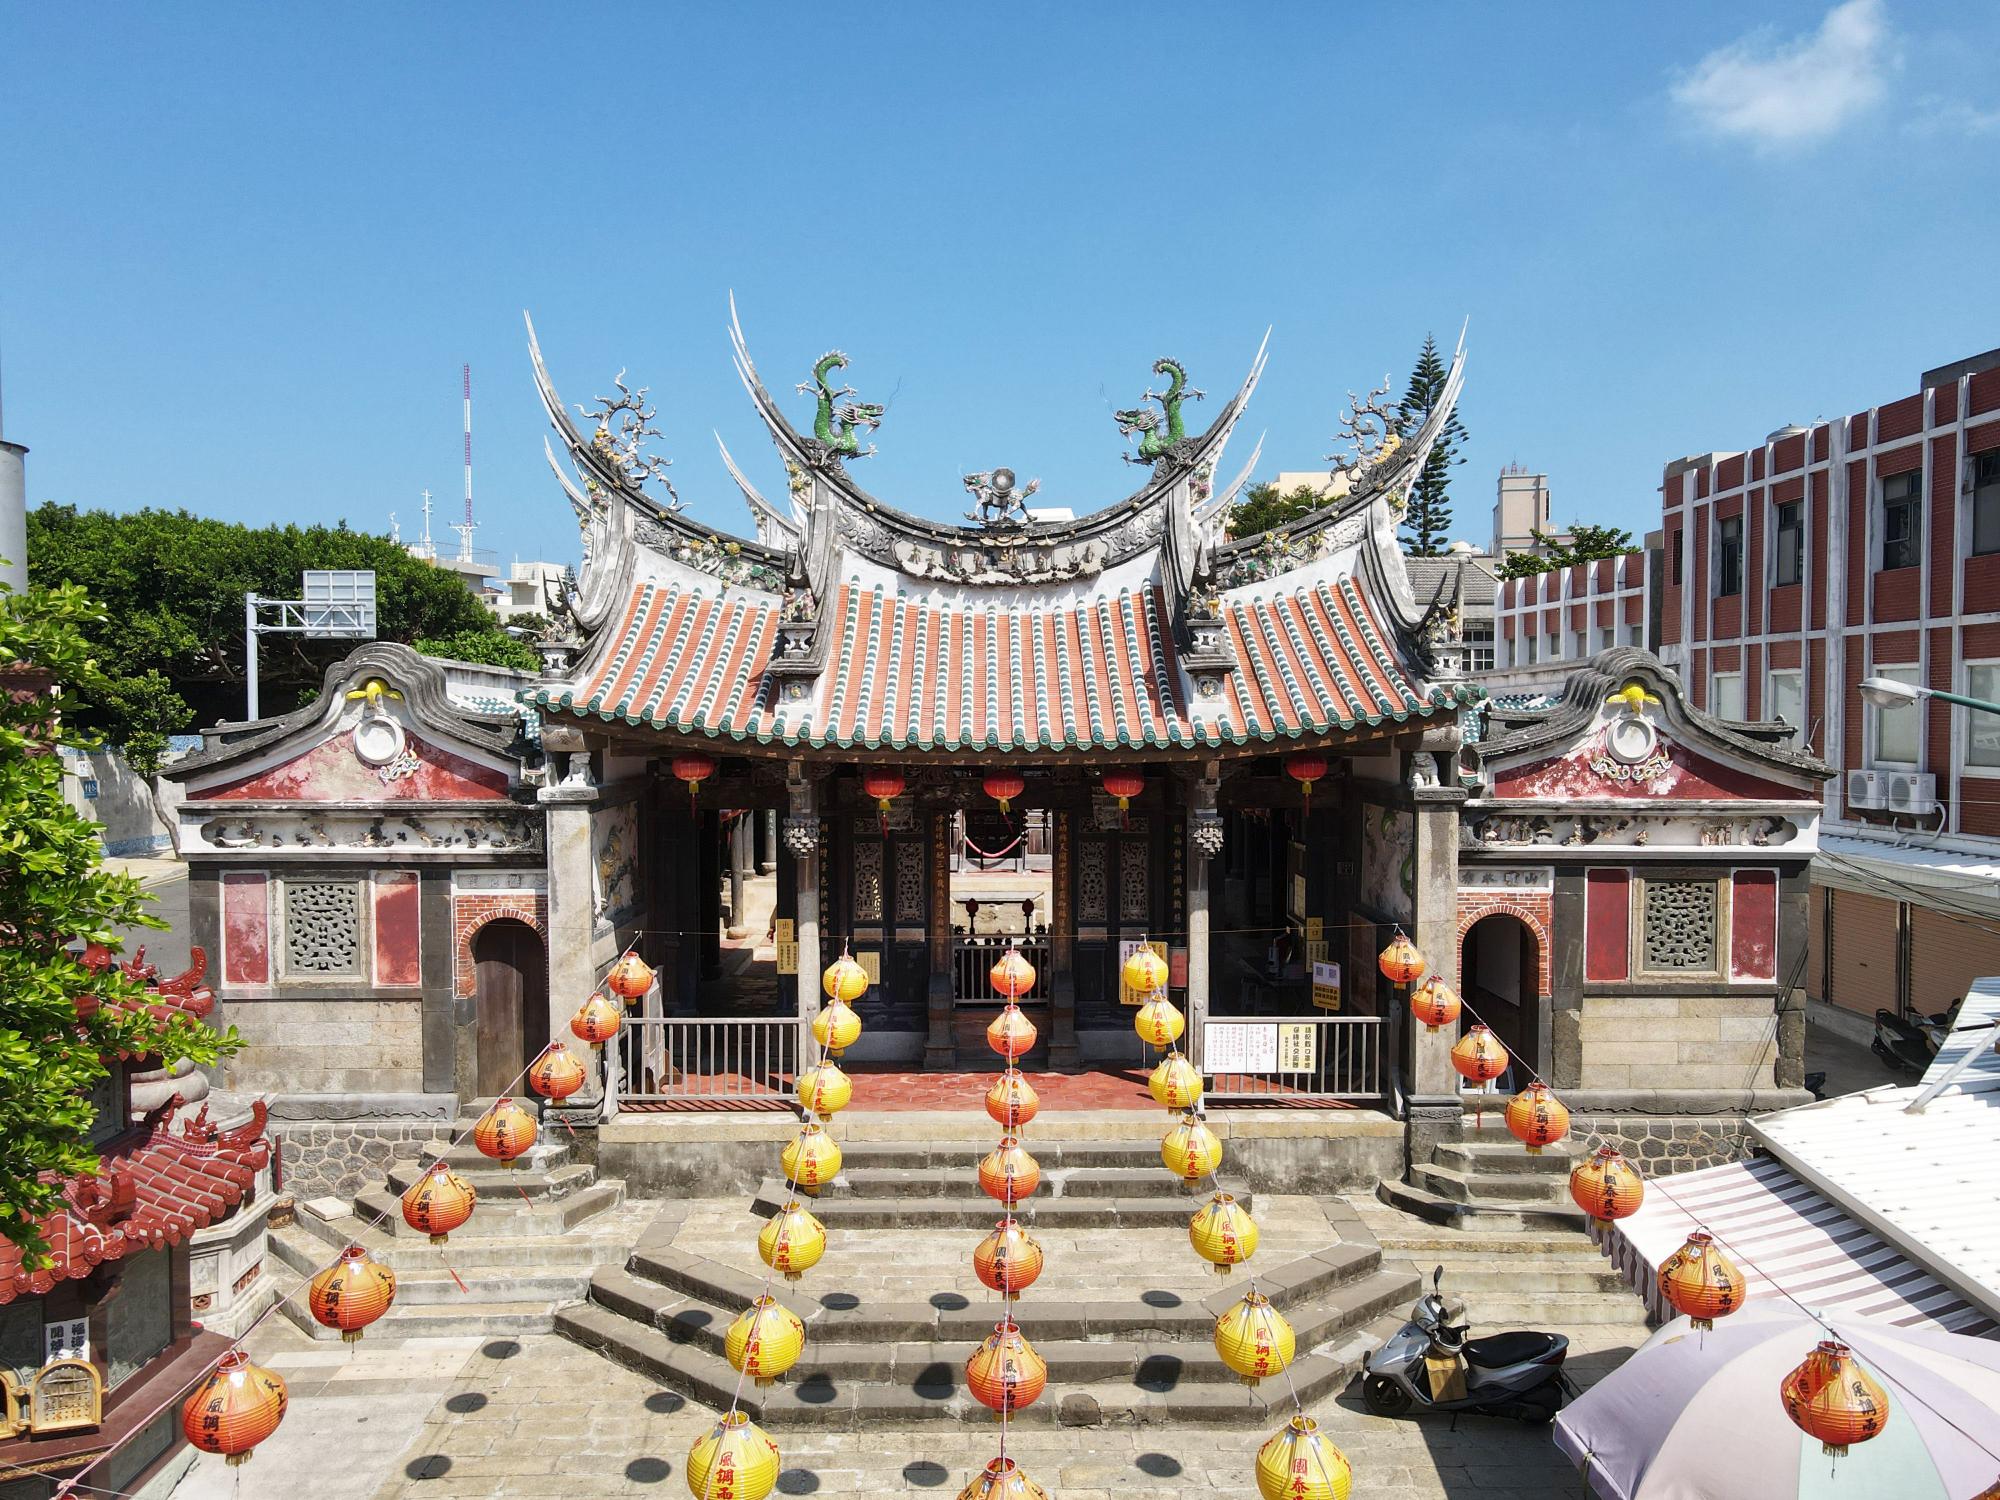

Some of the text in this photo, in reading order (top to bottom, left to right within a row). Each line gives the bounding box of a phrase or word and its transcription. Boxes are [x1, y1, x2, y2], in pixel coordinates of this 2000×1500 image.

[203, 1397, 222, 1451] 風調雨
[1292, 1457, 1310, 1500] 國泰
